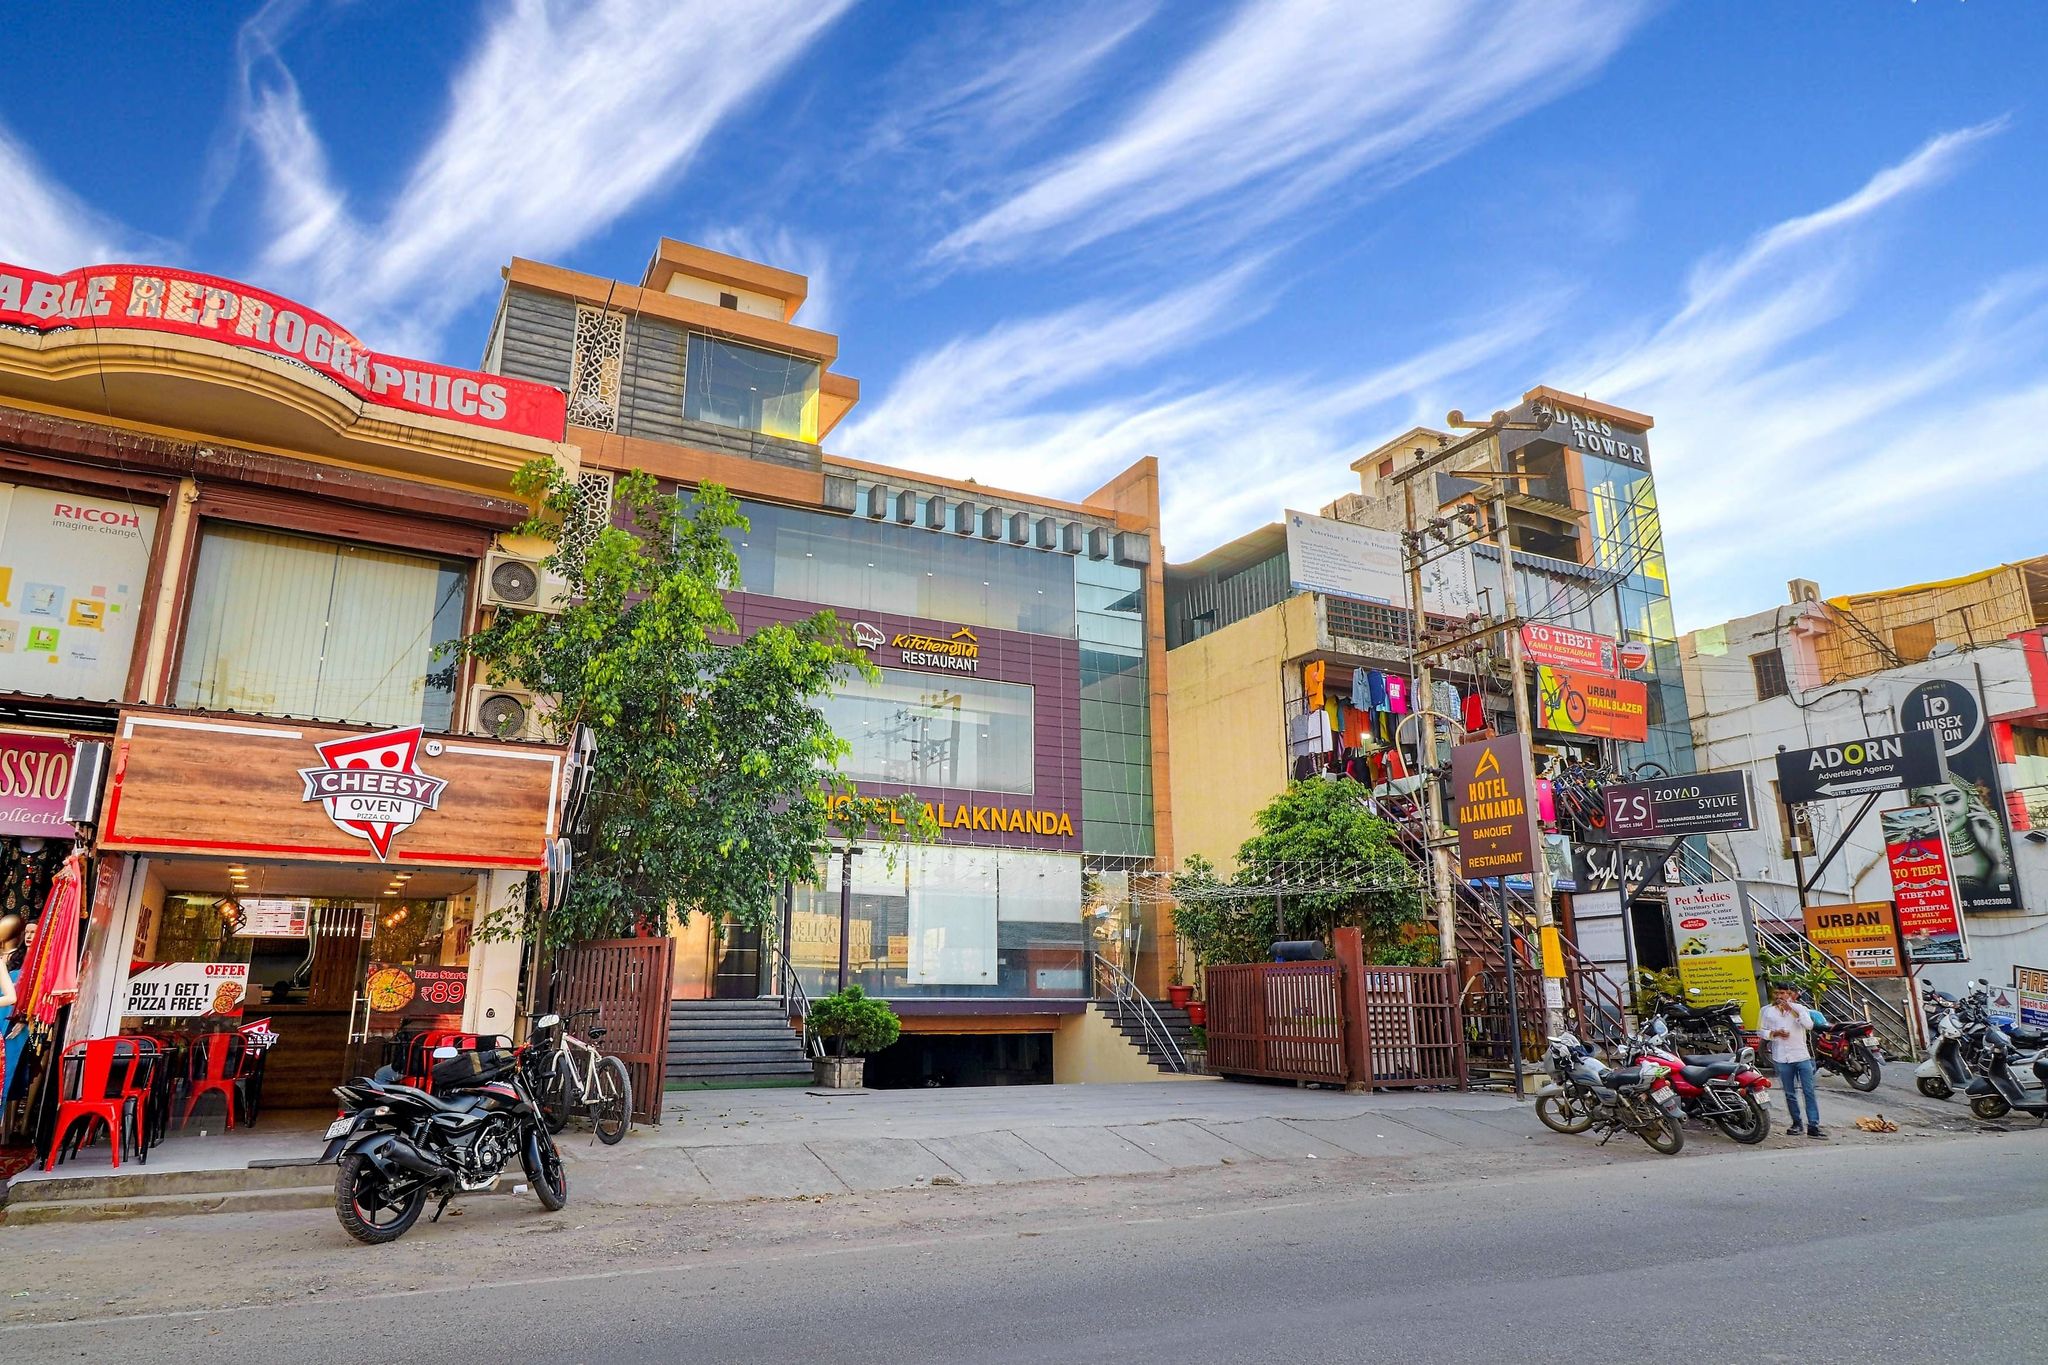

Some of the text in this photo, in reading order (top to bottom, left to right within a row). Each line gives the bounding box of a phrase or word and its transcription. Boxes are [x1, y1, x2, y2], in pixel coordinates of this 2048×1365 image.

[0, 273, 117, 320] ABLE
[1574, 430, 1645, 465] TOWER
[54, 503, 140, 529] RICOH
[52, 518, 97, 533] imagine.
[1529, 626, 1593, 650] YO TIBET
[1528, 641, 1553, 651] FAMILY
[1554, 645, 1597, 659] RESTAURANT
[902, 651, 979, 672] RESTAURANT
[1587, 685, 1617, 699] URBAN
[1587, 697, 1643, 715] TRAILBLAZER
[1916, 714, 1963, 731] UNISEX
[1808, 737, 1903, 771] ADORN
[0, 748, 73, 801] SSIO
[1818, 764, 1894, 781] Advertising Agency
[321, 773, 432, 799] CHEESY
[1468, 778, 1509, 803] HOTEL
[350, 798, 401, 813] OVEN
[1698, 796, 1739, 809] SYLVIE
[0, 807, 70, 826] ollectio
[918, 802, 1074, 836] ALAKNANDA
[1460, 798, 1524, 824] ALAKNANDA
[1473, 825, 1513, 840] BANQUET
[1468, 852, 1523, 868] RESTAURANT
[1586, 847, 1644, 890] Sylie
[1893, 864, 1943, 879] YO TIBET
[1674, 892, 1731, 906] Pet Medics
[1899, 889, 1945, 900] TIBETAN
[1682, 904, 1710, 912] Veterinary
[1900, 904, 1950, 914] CONTINENTAL
[1911, 911, 1940, 919] FAMILY
[1817, 911, 1881, 928] URBAN
[1902, 917, 1953, 927] RESTAURANT
[1809, 925, 1892, 939] TRAILBLAZER
[1854, 948, 1893, 956] TREK
[205, 965, 246, 976] OFFER
[415, 969, 439, 979] Pizza
[132, 983, 210, 997] BUY 1 GET 1
[127, 997, 166, 1011] PIZZA
